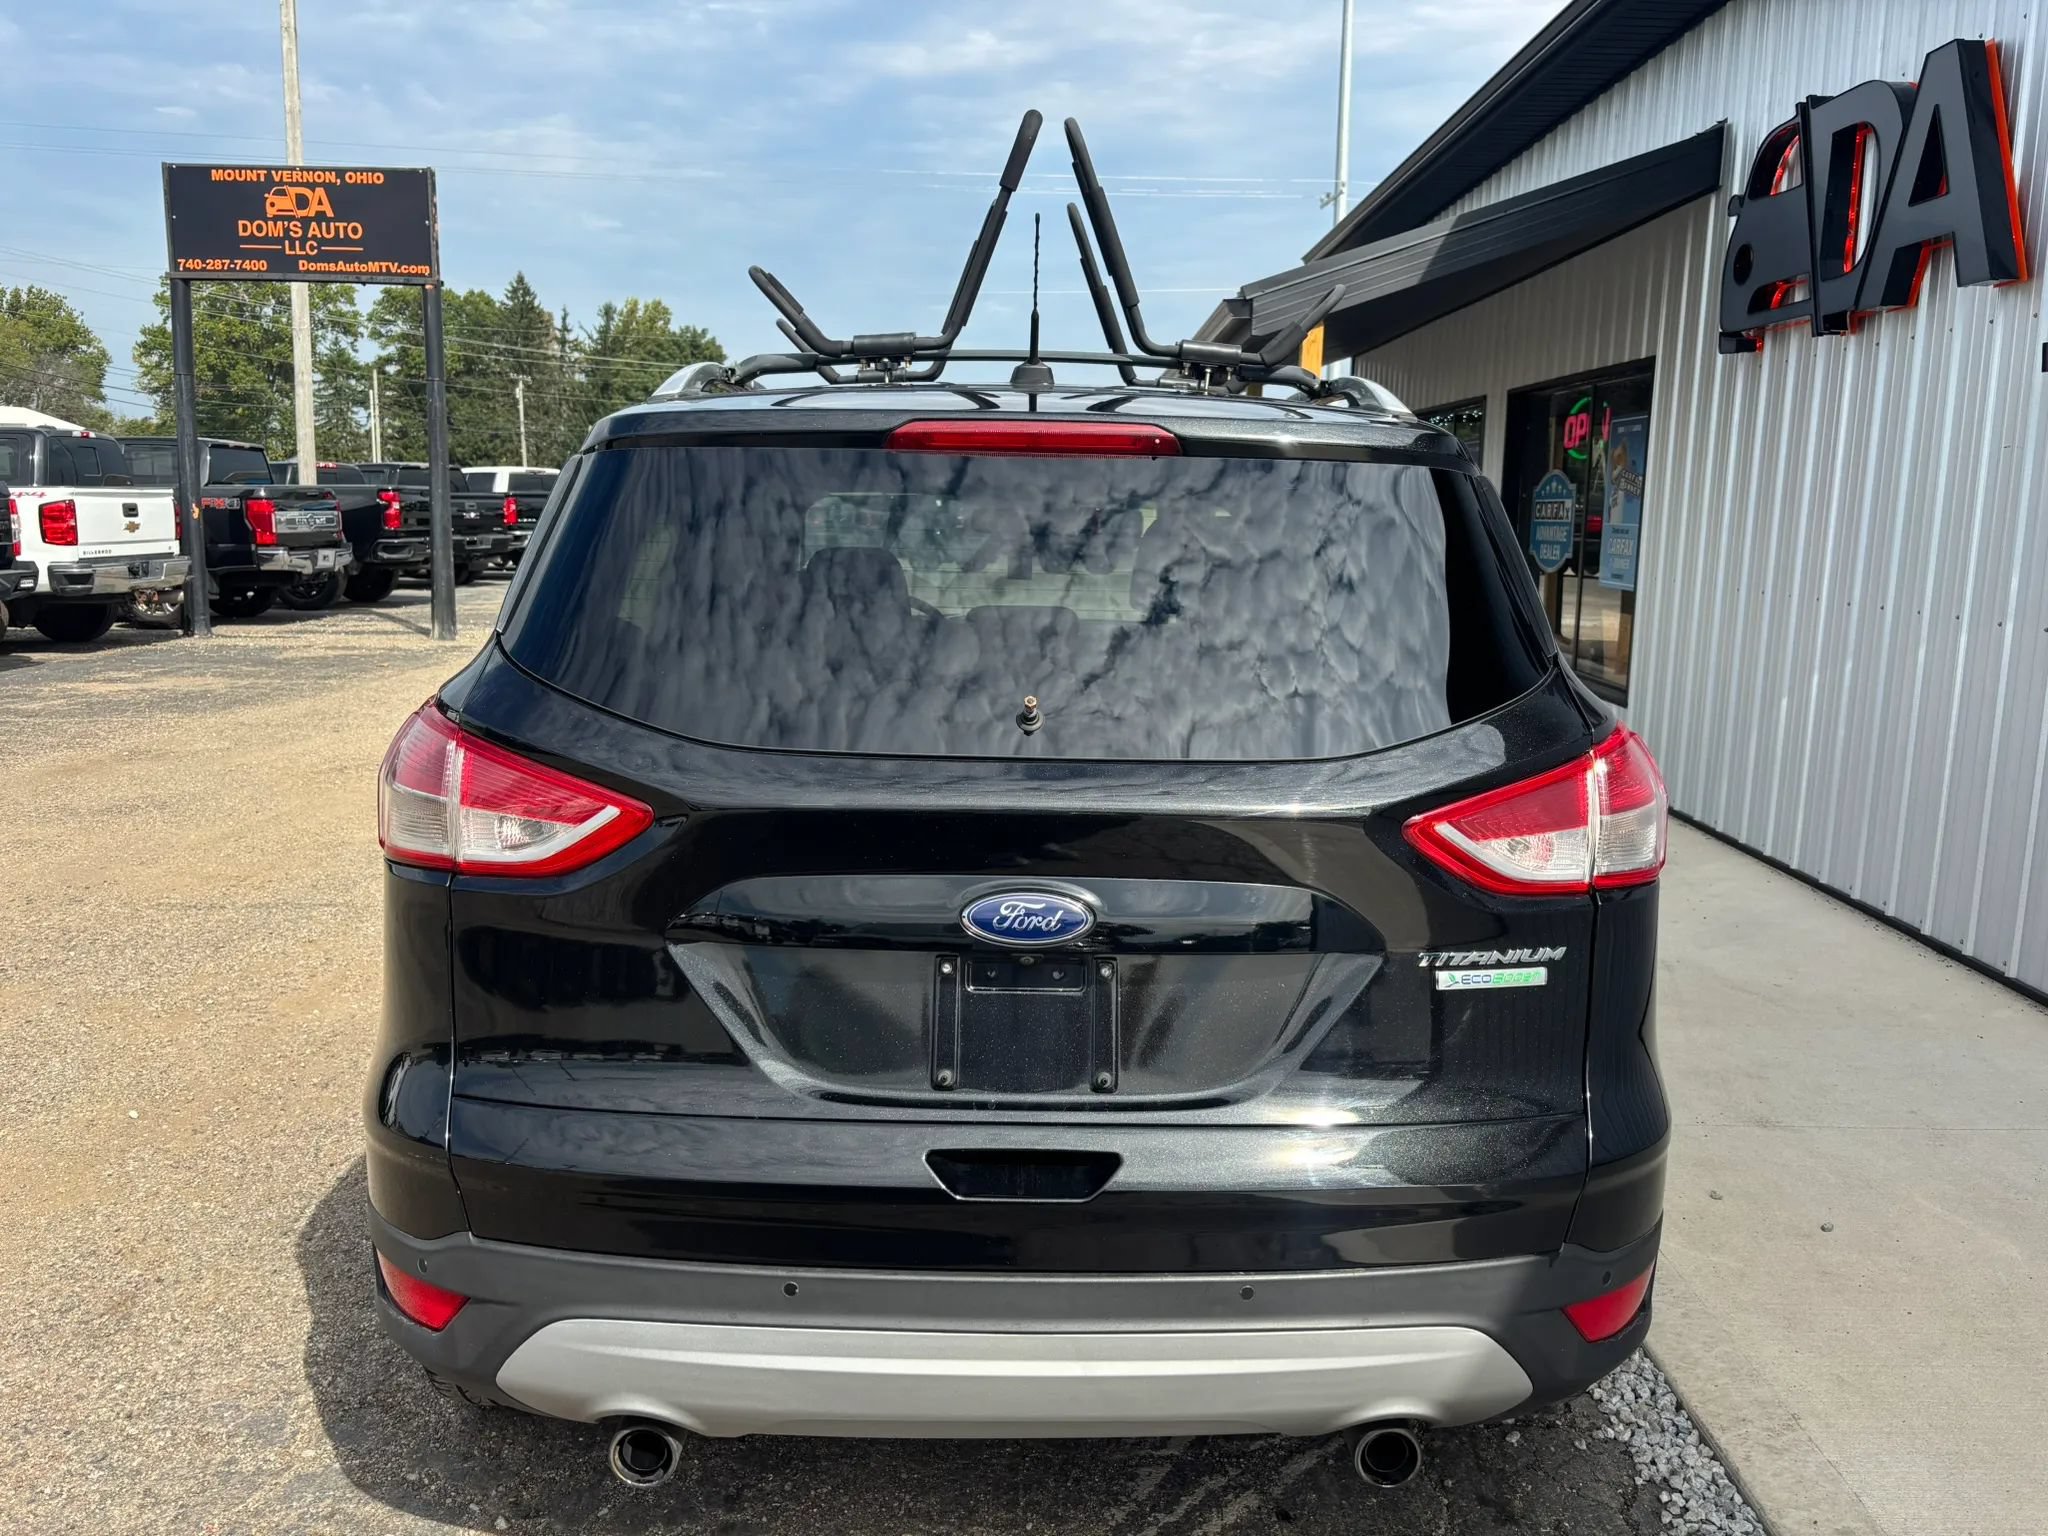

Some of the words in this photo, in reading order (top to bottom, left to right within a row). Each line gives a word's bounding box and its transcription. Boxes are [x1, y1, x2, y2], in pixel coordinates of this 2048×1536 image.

[211, 169, 267, 182] MOUNT
[272, 170, 341, 185] VERNON,
[345, 172, 384, 184] OHIO
[238, 220, 303, 239] DOM'S
[308, 222, 363, 239] AUTO
[285, 240, 318, 255] LLC
[177, 259, 267, 271] 740-287-7400
[299, 260, 430, 275] DomsAutoMTV.com
[1535, 501, 1571, 520] CARFAX
[993, 901, 1064, 931] Ford
[1418, 946, 1567, 967] TITANIUM
